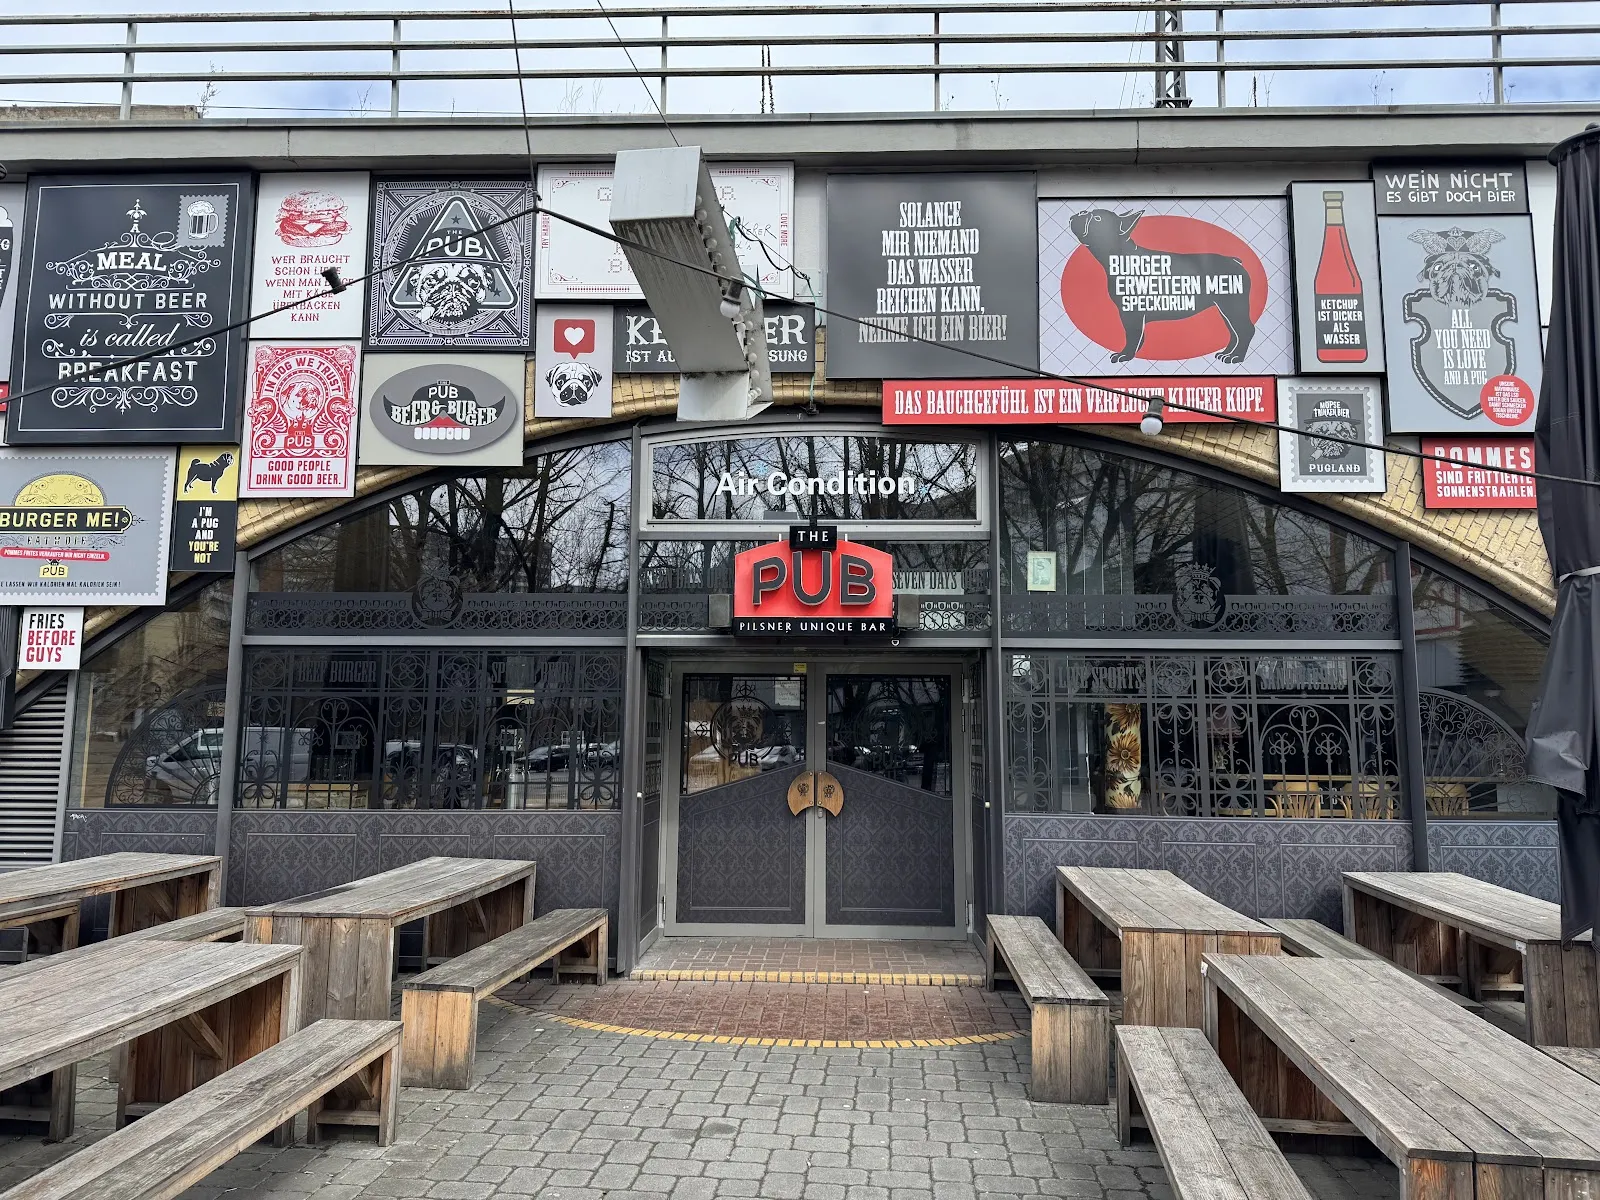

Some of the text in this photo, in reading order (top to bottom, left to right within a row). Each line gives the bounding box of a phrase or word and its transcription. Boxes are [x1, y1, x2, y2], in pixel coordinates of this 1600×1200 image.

[1386, 190, 1402, 203] ES
[1446, 190, 1482, 203] DOCH
[899, 200, 961, 228] SOLANGE
[780, 213, 788, 247] LOVE MORE
[426, 236, 484, 257] PUB
[541, 237, 549, 249] TRY
[882, 228, 980, 256] MIR NIEMAND
[97, 252, 167, 271] MEAL
[272, 254, 350, 264] WER BRAUCHT
[1109, 255, 1171, 276] BURGER
[274, 266, 310, 275] SCHON
[887, 257, 973, 285] DAS WASSER
[265, 278, 296, 287] WENN
[298, 278, 321, 287] MAN
[1116, 274, 1244, 296] ERWEITERN MEIN
[49, 292, 207, 310] WITHOUT BEER
[283, 289, 303, 298] MIT
[876, 286, 985, 314] REICHEN KANN,
[1320, 299, 1358, 310] KETCHUP
[290, 313, 320, 322] KANN
[1318, 310, 1363, 322] IST DICKER
[1451, 309, 1473, 329] ALL
[79, 323, 180, 347] is called
[858, 314, 1008, 343] NEHME ICH EIN BIER!
[1333, 322, 1350, 333] ALS
[1323, 333, 1361, 345] WASSER
[1434, 328, 1492, 349] YOU NEED
[626, 350, 652, 363] IST
[768, 349, 808, 362] SUNG
[1443, 349, 1487, 369] IS LOVE
[58, 361, 198, 382] BREAKFAST
[264, 357, 342, 393] IN DOG WE TRUST
[1444, 370, 1488, 385] AND A PUG
[428, 386, 459, 398] PUB
[895, 390, 922, 415] DAS
[927, 386, 1029, 415] BAUCHGEFÜHL
[1034, 388, 1056, 414] IST
[1059, 388, 1082, 414] EIN
[1168, 387, 1223, 413] KLUGER
[1226, 386, 1265, 413] KOPF.
[1319, 400, 1341, 409] MOPSE
[391, 400, 497, 426] BEER & BURGER
[287, 435, 312, 447] PUB
[1435, 446, 1532, 469] POMMES
[267, 460, 331, 472] GOOD PEOPLE
[1309, 463, 1361, 473] PUGLAND
[256, 473, 341, 485] DRINK GOOD BEER.
[715, 469, 915, 496] Air Condition
[1436, 470, 1533, 485] SIND FRITTIERTE
[1436, 485, 1537, 498] SONNENSTRAHLEN.
[0, 511, 120, 528] BURGER ME!
[199, 506, 213, 517] I'M
[191, 517, 219, 529] A PUG
[195, 530, 214, 540] AND
[797, 530, 829, 542] THE
[188, 541, 219, 552] YOU'RE
[193, 552, 212, 564] NOT
[42, 566, 65, 576] PUB
[752, 550, 877, 606] PUB
[892, 571, 926, 590] SEVEN
[929, 571, 958, 590] DAYS
[29, 613, 65, 629] FRIES
[739, 621, 886, 634] PILSNER UNIQUE BAR
[27, 630, 76, 646] BEFORE
[26, 647, 62, 663] GUYS
[330, 660, 377, 682] BURGER
[1092, 666, 1143, 689] SPORTS
[728, 751, 759, 767] PUB
